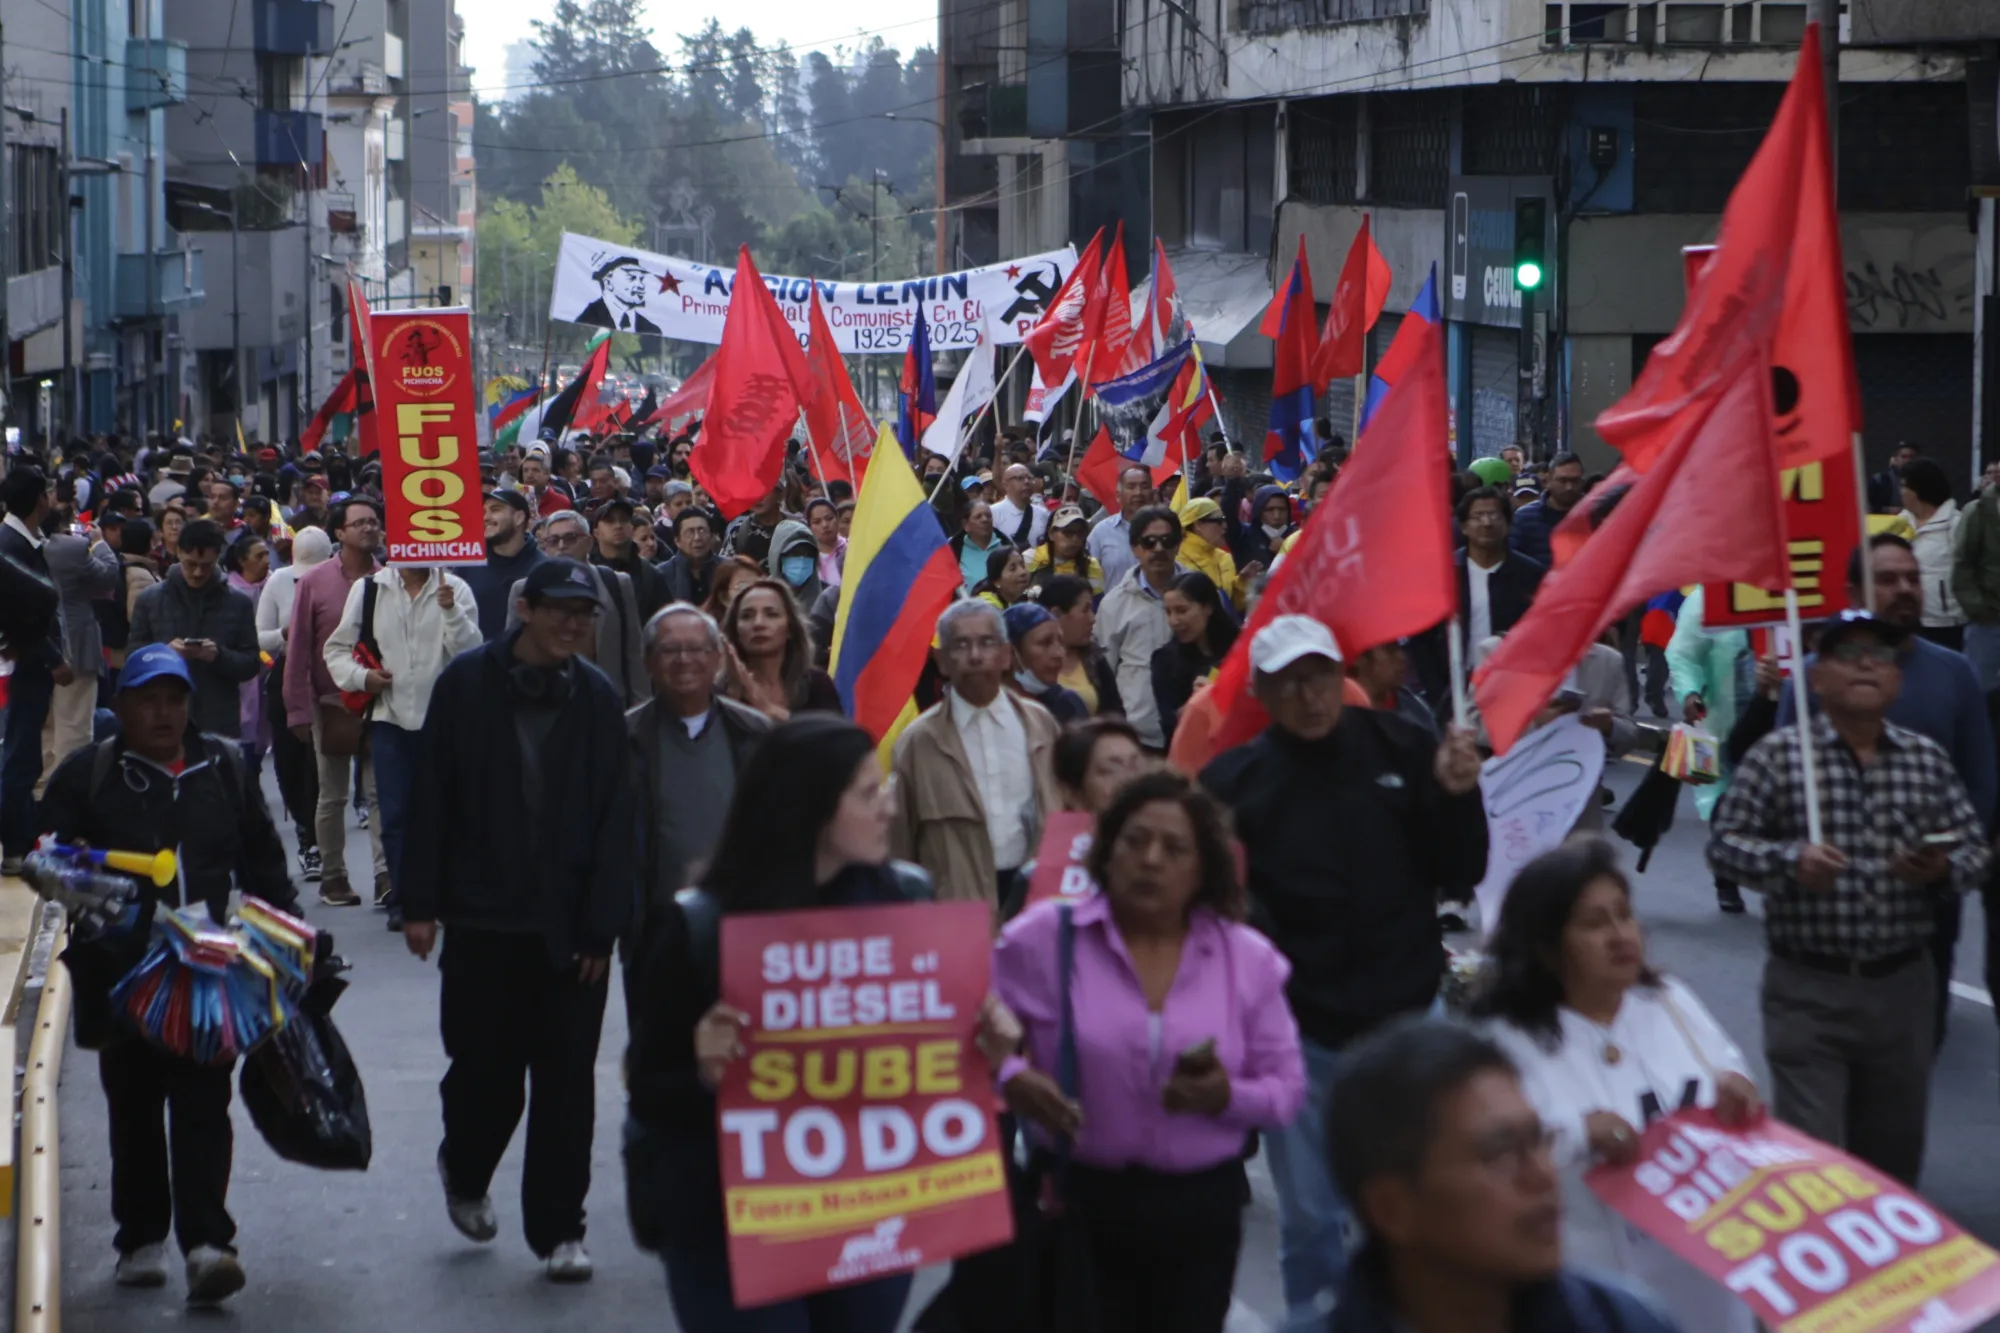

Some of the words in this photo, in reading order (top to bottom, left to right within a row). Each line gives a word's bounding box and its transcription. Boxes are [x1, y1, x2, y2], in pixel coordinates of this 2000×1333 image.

[831, 304, 917, 328] Comunist
[933, 304, 956, 323] En
[402, 366, 444, 377] FUOS
[396, 403, 464, 542] FUOS
[390, 541, 483, 558] PICHINCHA
[762, 936, 894, 984] SUBE
[762, 979, 956, 1032] DIÉSEL
[748, 1040, 963, 1101] SUBE
[720, 1099, 987, 1179] TODO
[1724, 1193, 1943, 1316] TODO
